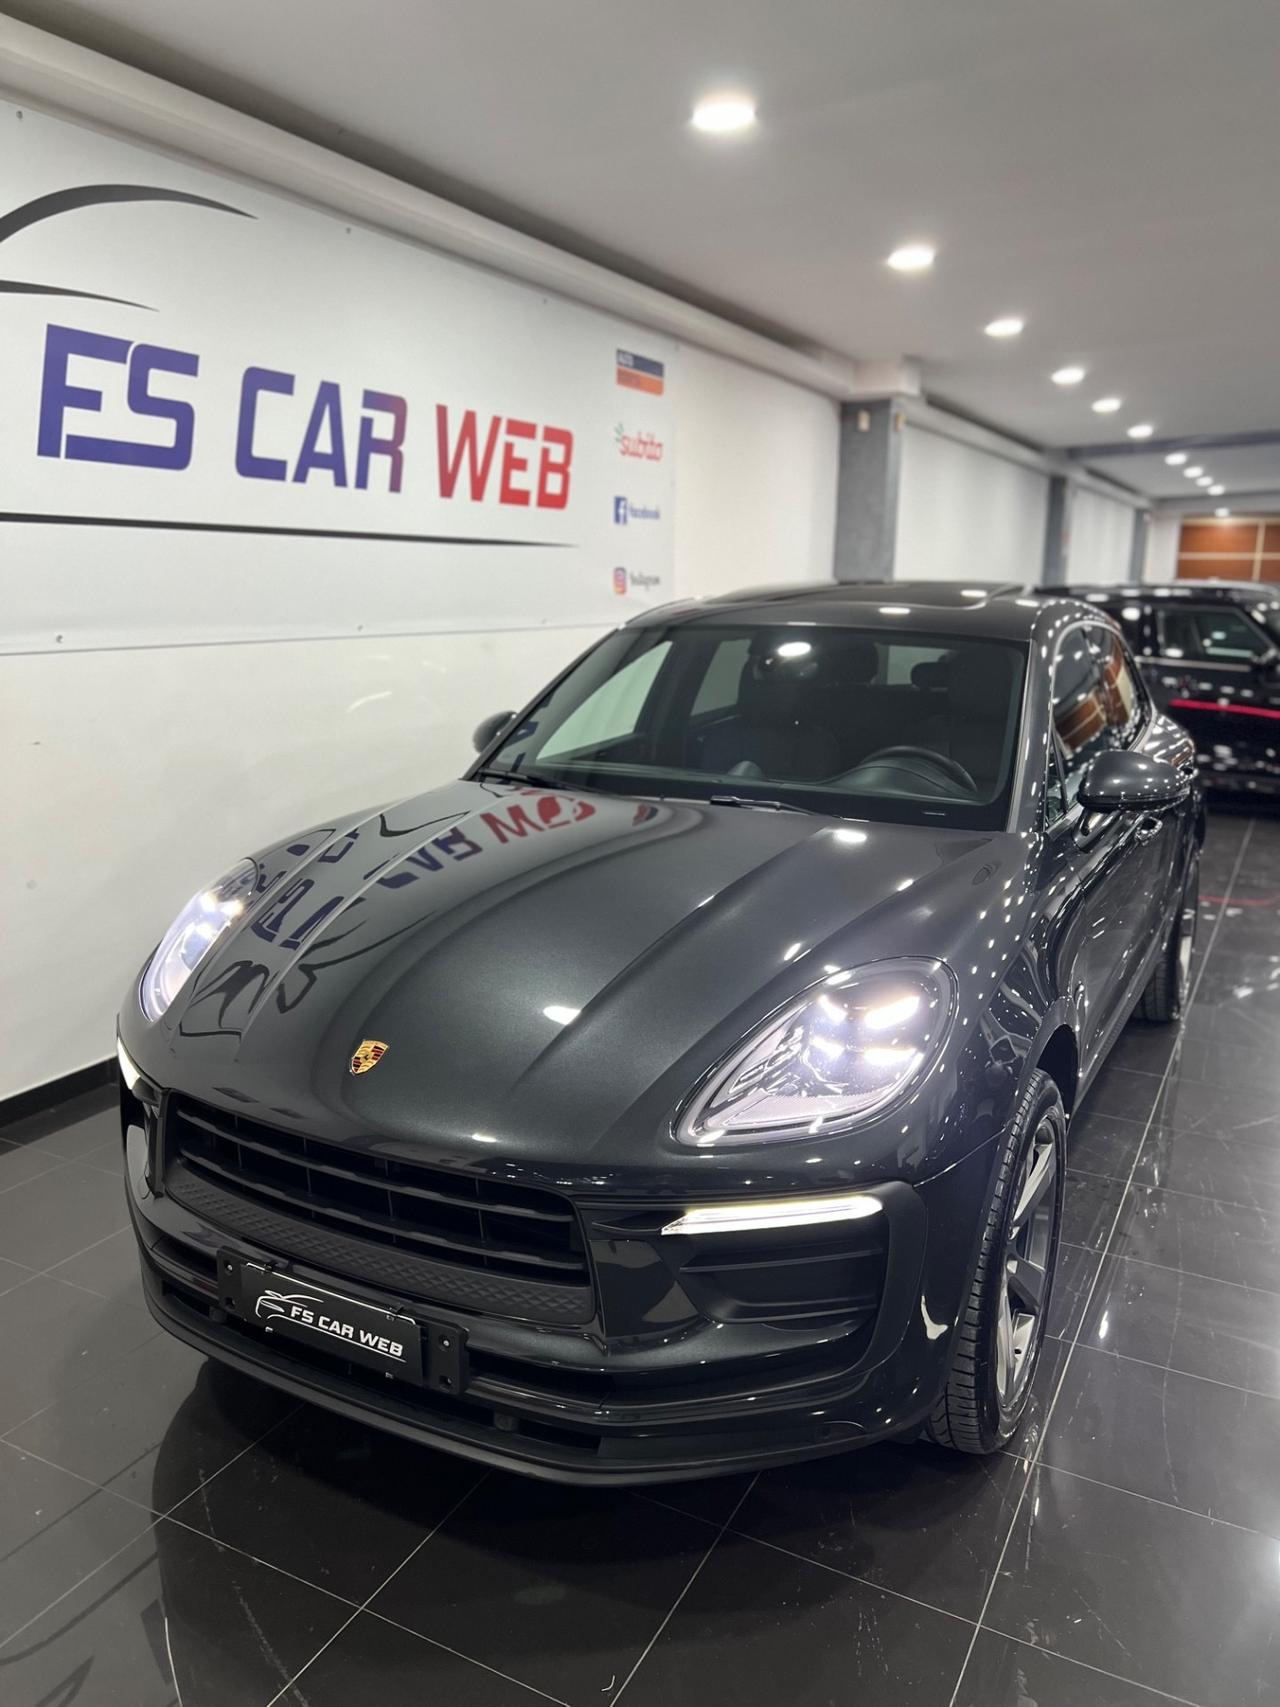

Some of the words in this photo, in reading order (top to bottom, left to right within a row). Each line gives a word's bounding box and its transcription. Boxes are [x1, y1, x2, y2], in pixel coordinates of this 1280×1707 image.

[37, 323, 200, 471] FS
[235, 366, 407, 493] CAR
[435, 403, 574, 510] WEB
[290, 1305, 315, 1323] FS
[318, 1315, 353, 1339] CAR
[359, 1329, 404, 1357] WEB
